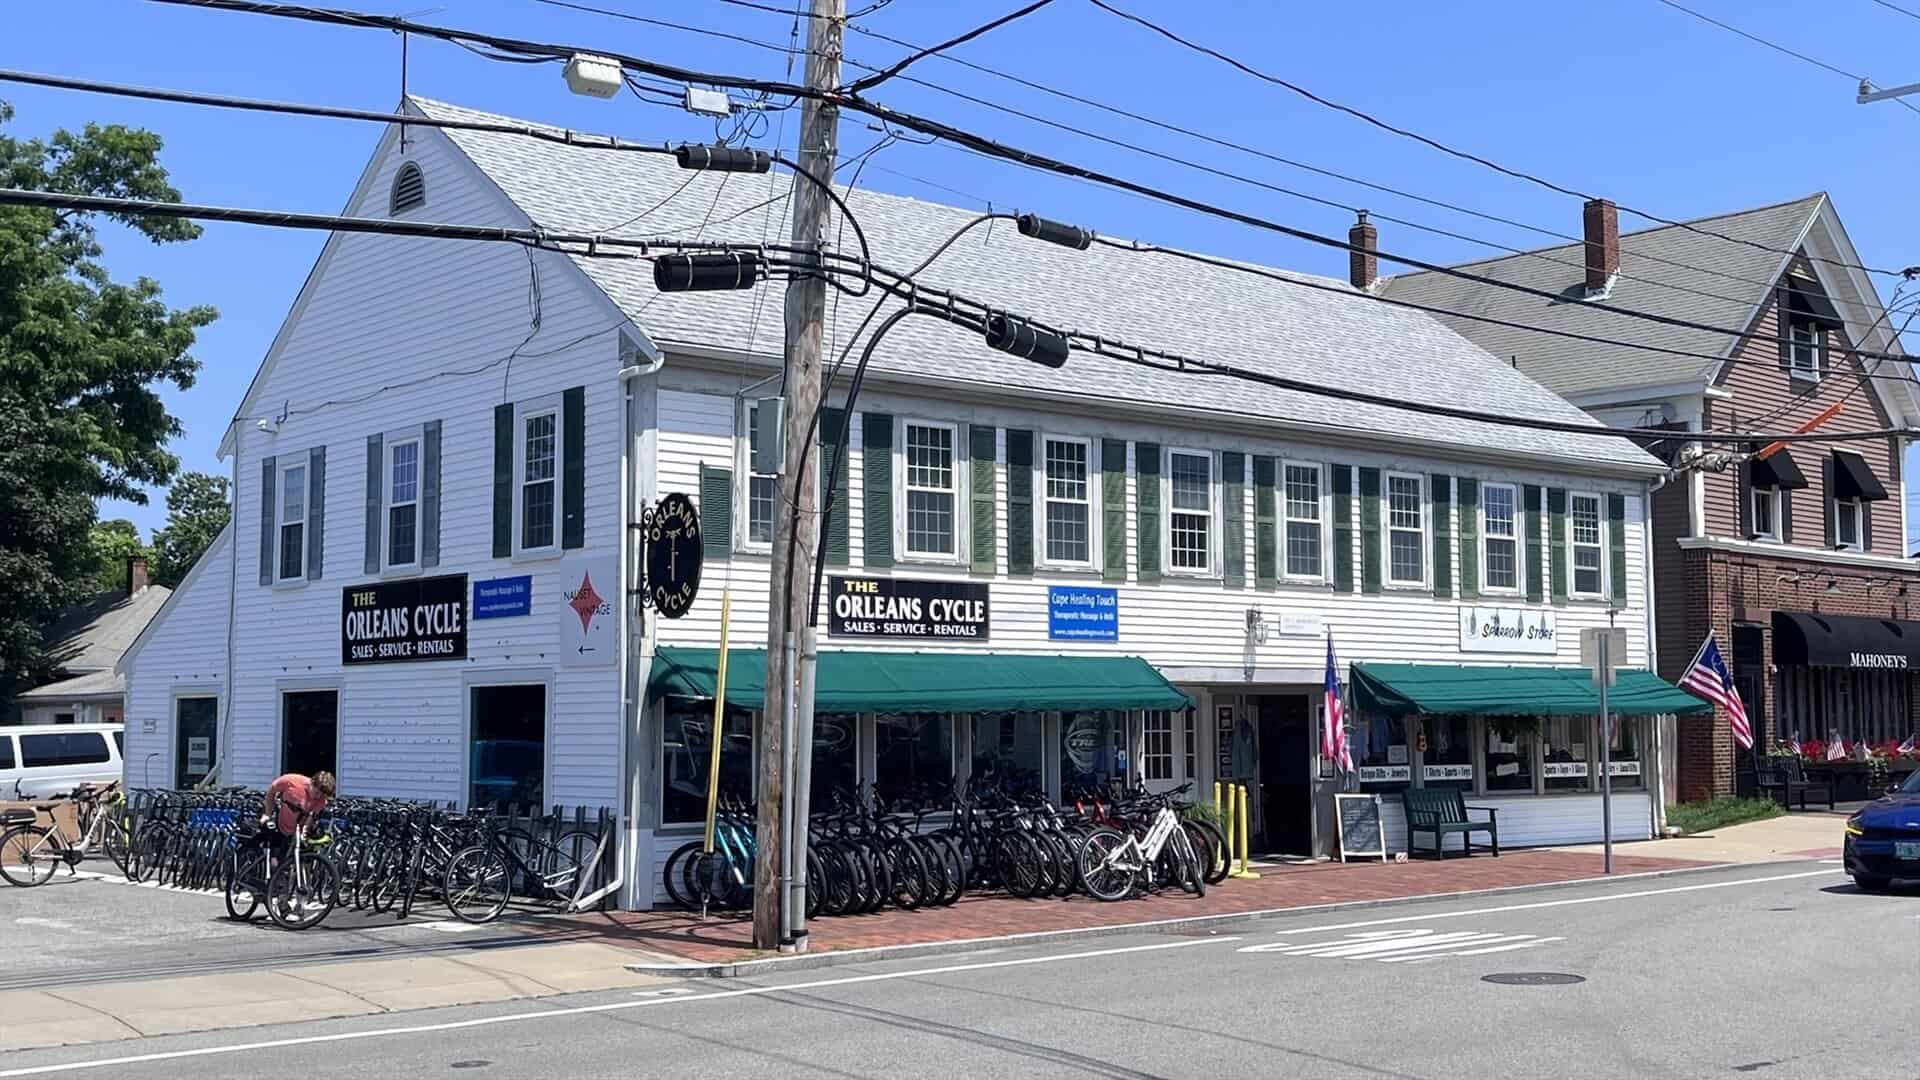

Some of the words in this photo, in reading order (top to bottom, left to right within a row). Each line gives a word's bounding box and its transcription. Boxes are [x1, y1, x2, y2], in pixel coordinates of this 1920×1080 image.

[652, 501, 696, 541] ORLEANS
[844, 581, 879, 593] THE
[352, 592, 376, 607] THE
[563, 590, 591, 601] NAUSET
[656, 582, 692, 610] CYCLE
[1052, 593, 1069, 607] Cape
[1070, 592, 1095, 608] Healing
[1096, 594, 1115, 606] Touch
[579, 603, 612, 616] VINTAGE
[835, 594, 922, 621] ORLEANS
[929, 599, 985, 623] CYCLE
[346, 606, 409, 641] ORLEANS
[414, 602, 461, 636] CYCLE
[844, 621, 876, 633] SALES
[883, 622, 926, 635] SERVICE
[934, 624, 977, 637] RENTALS
[351, 645, 374, 659] SALES
[379, 642, 412, 657] SERVICE
[417, 640, 454, 655] RENTALS
[1850, 652, 1908, 669] MAHONEY'S
